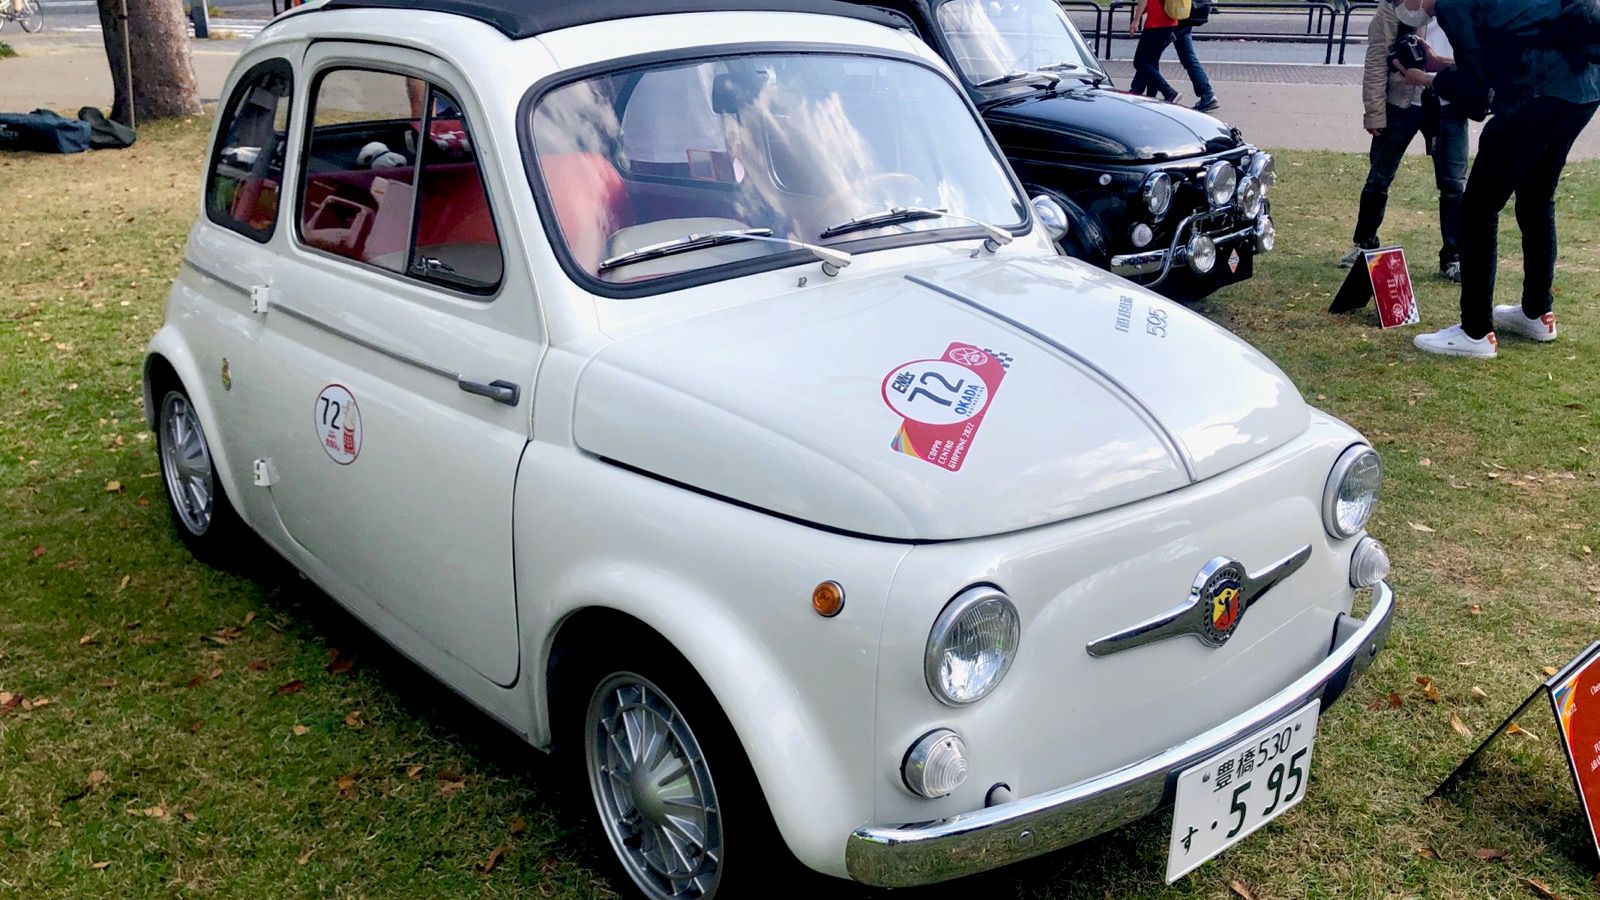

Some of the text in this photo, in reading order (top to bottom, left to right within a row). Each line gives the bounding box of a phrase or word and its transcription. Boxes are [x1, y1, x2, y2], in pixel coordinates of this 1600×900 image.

[1146, 306, 1169, 339] 595
[907, 371, 965, 407] 72
[954, 384, 981, 415] OKADA
[320, 396, 341, 430] 72
[927, 439, 943, 461] COPPA
[937, 439, 955, 464] CENTRO
[948, 422, 975, 468] GIAPPONE 2022
[1180, 826, 1199, 855] す
